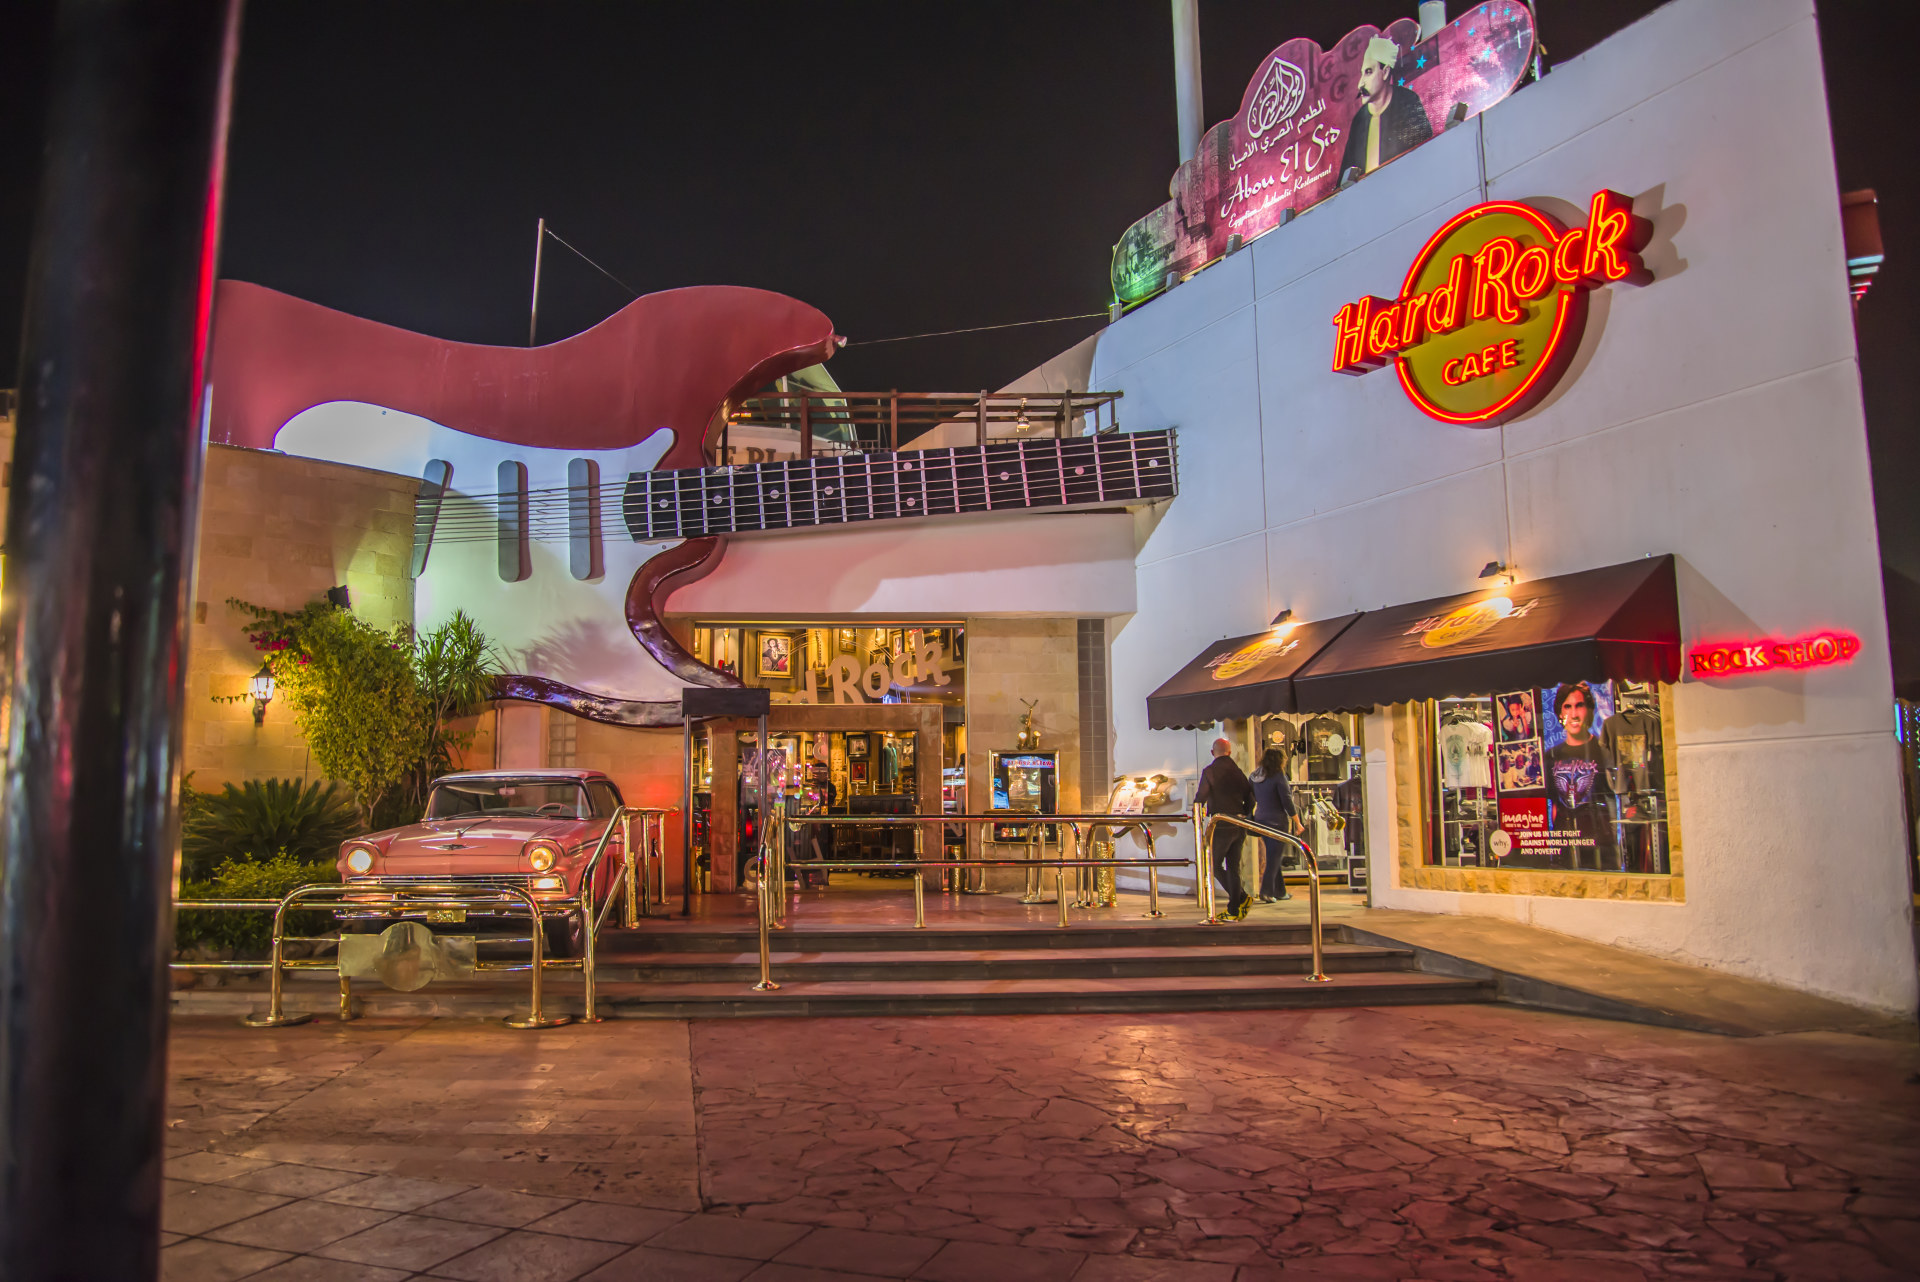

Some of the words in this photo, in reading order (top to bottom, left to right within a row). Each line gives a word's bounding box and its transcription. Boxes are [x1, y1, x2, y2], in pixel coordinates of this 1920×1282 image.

[1221, 174, 1275, 218] Abou
[1280, 142, 1299, 183] El
[1332, 252, 1468, 374] Hard
[1472, 189, 1632, 323] Rock
[1441, 338, 1520, 386] CAFE
[825, 628, 951, 704] Rock
[1690, 645, 1766, 674] ROCK
[1772, 637, 1854, 666] SHOP
[1501, 810, 1544, 828] imagine
[1519, 830, 1533, 838] JOIN
[1520, 839, 1545, 847] AGAINST
